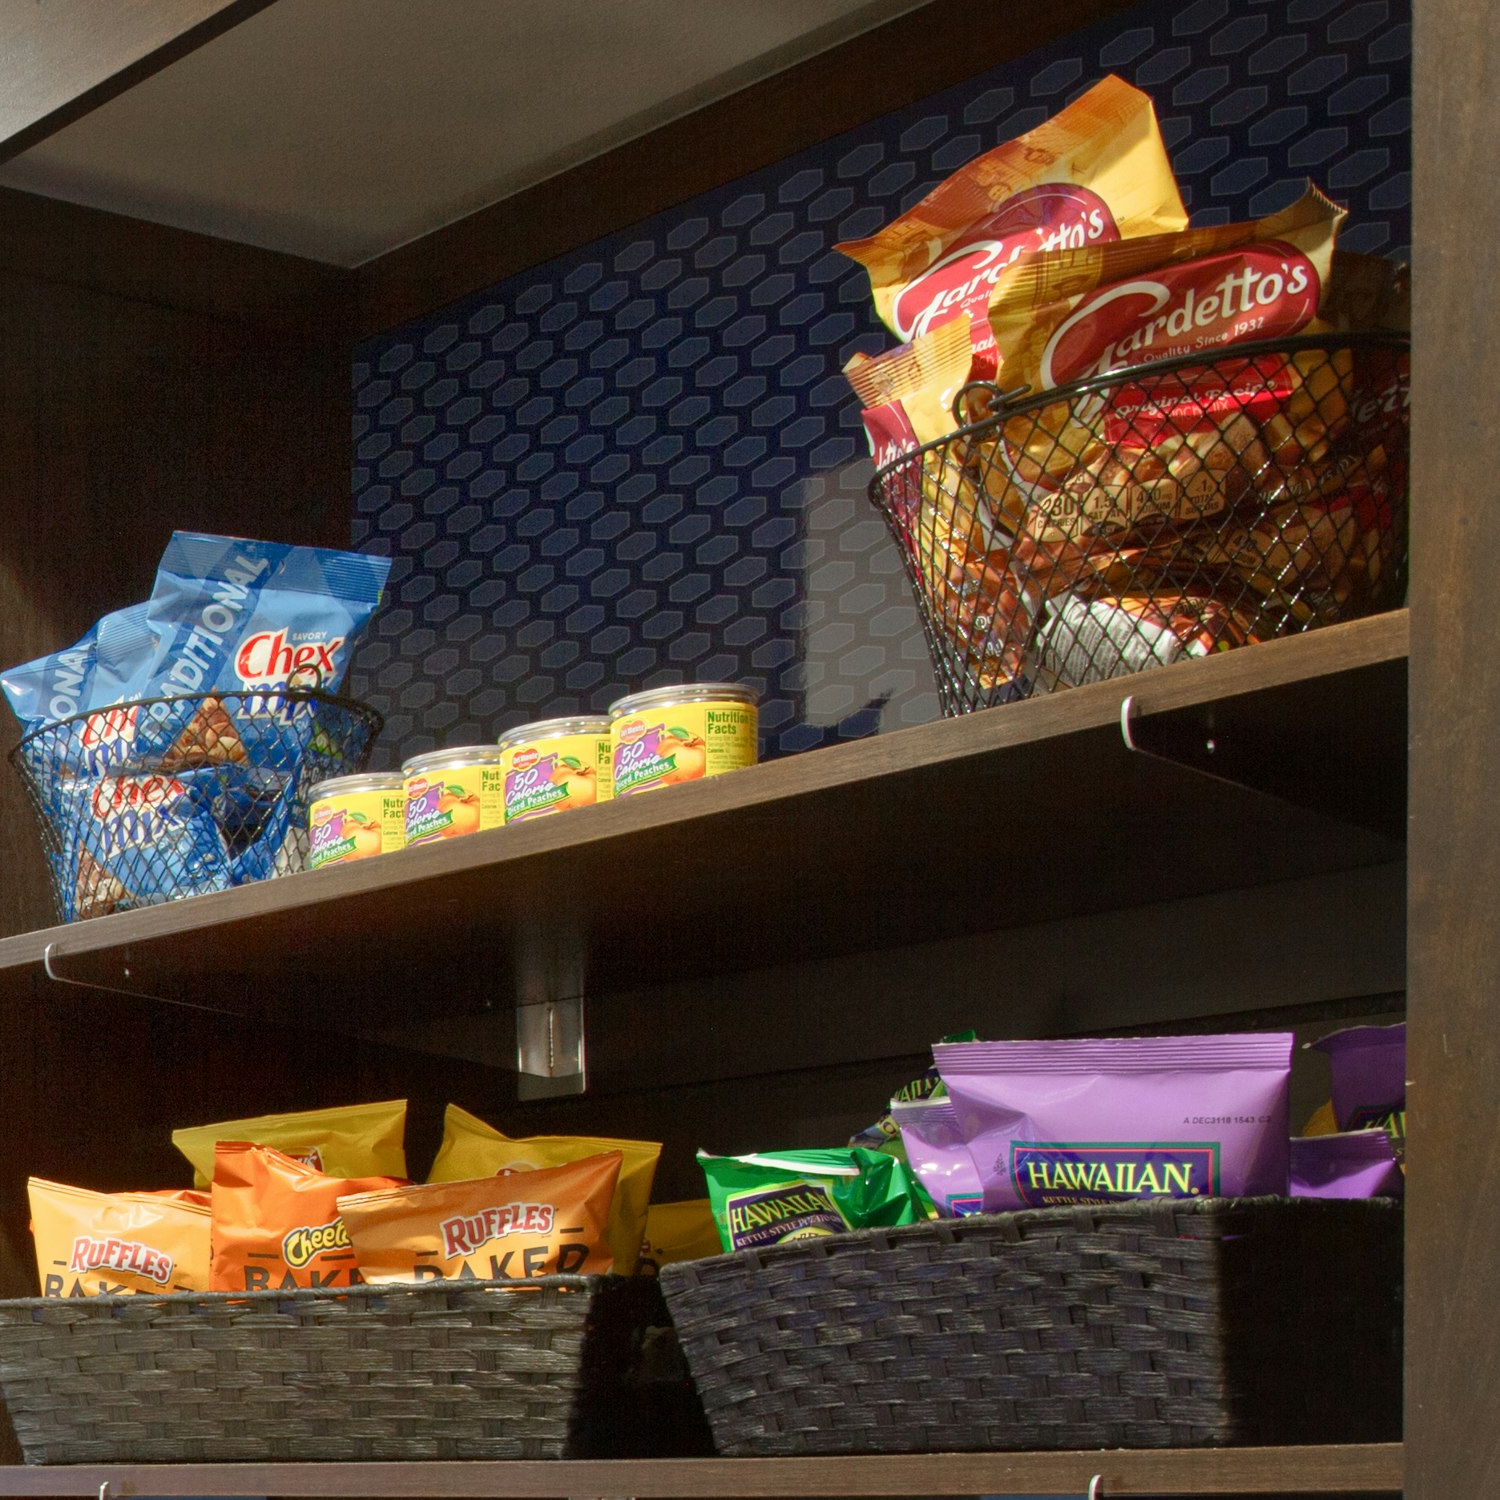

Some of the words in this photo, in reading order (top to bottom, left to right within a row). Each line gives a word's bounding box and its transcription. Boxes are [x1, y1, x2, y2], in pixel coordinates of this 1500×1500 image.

[1196, 332, 1228, 349] Since
[1233, 317, 1265, 336] 1932
[292, 631, 328, 642] SAVORY
[235, 632, 345, 680] Chex
[708, 724, 737, 735] Facts
[622, 741, 644, 763] 50
[614, 754, 660, 780] Calorie
[634, 762, 670, 778] Peaches
[514, 769, 538, 789] 50
[506, 781, 553, 806] Calorie
[527, 789, 564, 805] Peaches
[409, 798, 427, 817] 50
[315, 825, 331, 844] 50
[443, 1203, 554, 1259] RUFFLES
[71, 1236, 172, 1284] RUFFLES
